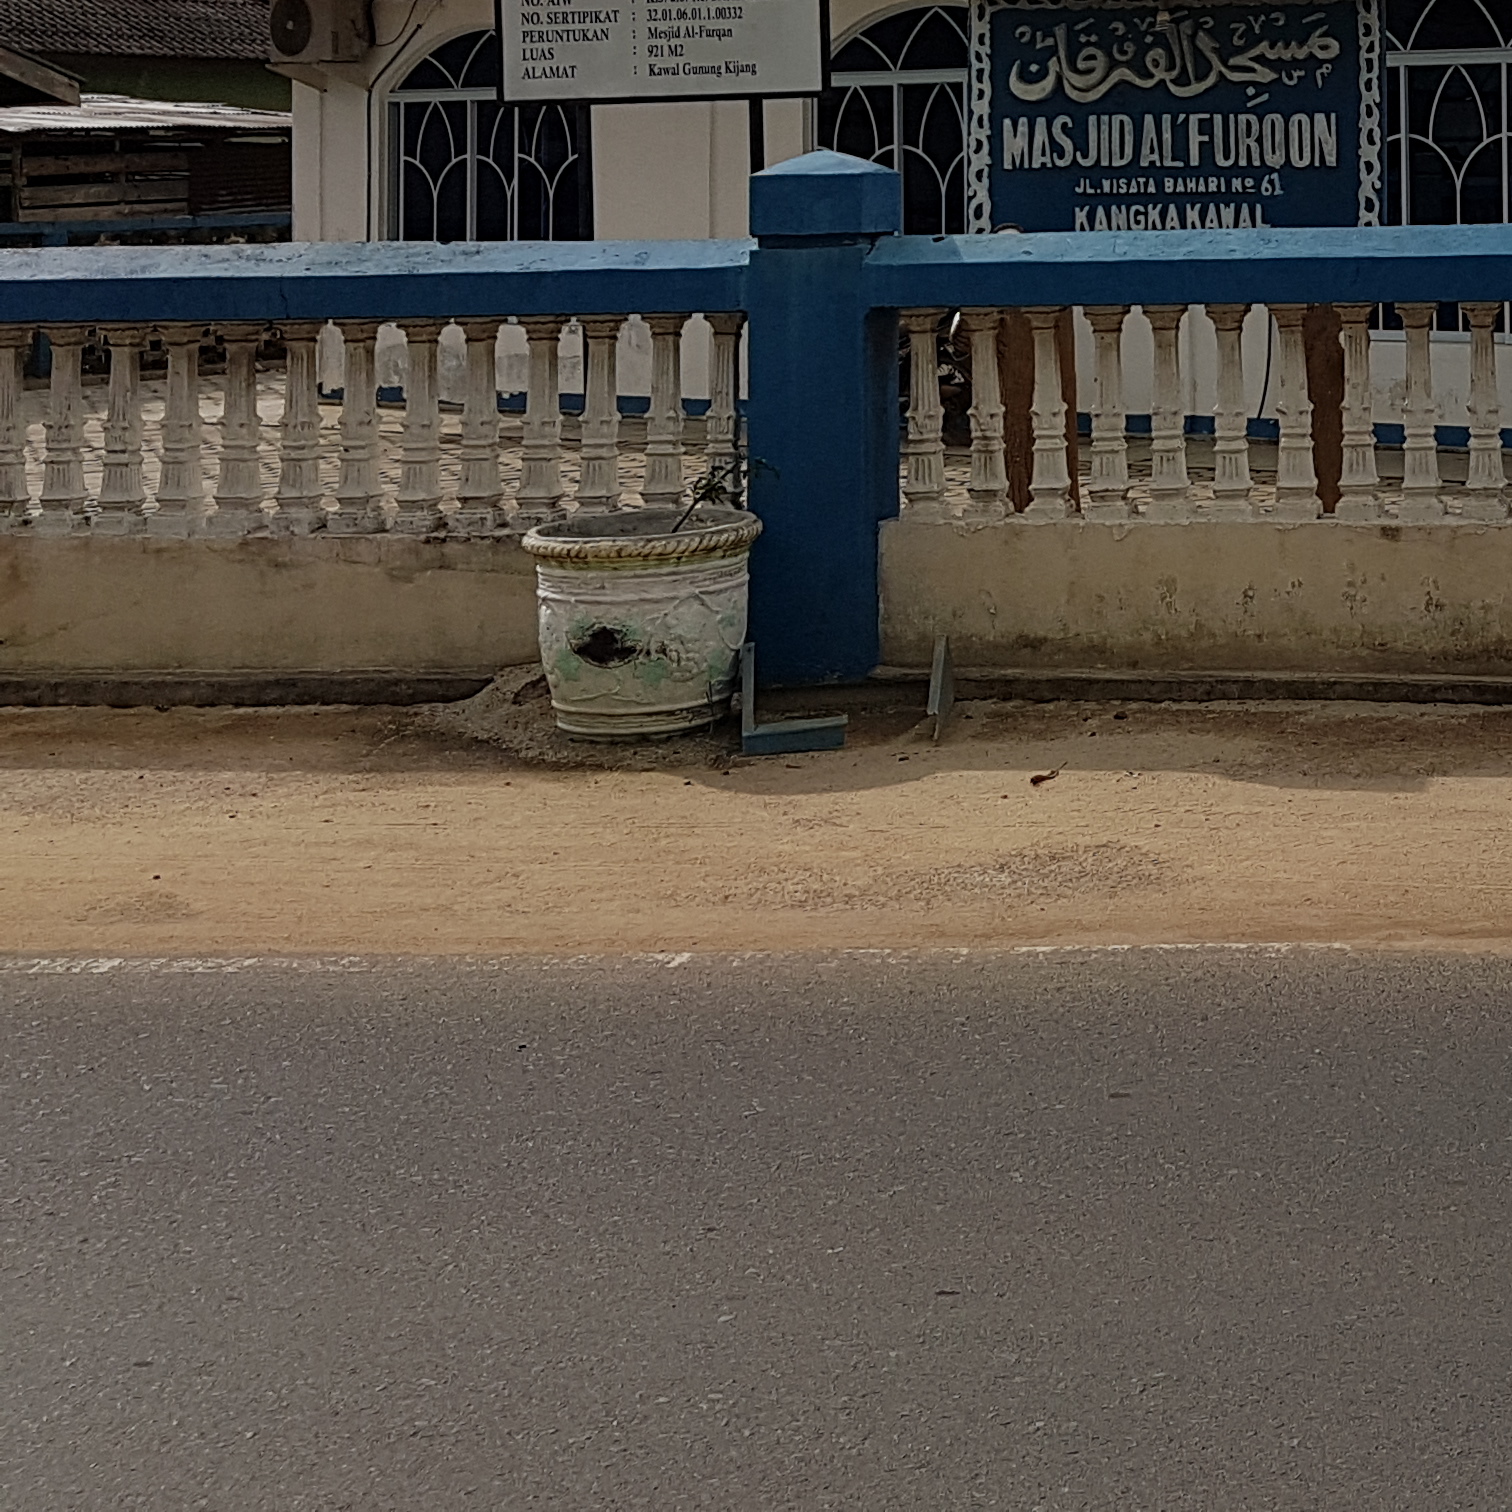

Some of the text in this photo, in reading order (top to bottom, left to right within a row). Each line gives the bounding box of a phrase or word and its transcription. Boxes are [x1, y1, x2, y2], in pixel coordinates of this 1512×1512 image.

[520, 11, 544, 26] NO.
[546, 9, 620, 25] SERTIPIKAT
[521, 27, 610, 44] PERUNTUKAN
[647, 25, 681, 42] Mesjid
[682, 24, 734, 42] Al-Furqan
[521, 47, 555, 62] LUAS
[646, 44, 665, 58] 921
[667, 44, 685, 58] M2
[521, 65, 577, 80] ALAMAT
[648, 63, 680, 77] Kawal
[682, 62, 722, 78] Gunung
[724, 60, 757, 77] Kijang
[1002, 113, 1134, 170] MASJID
[1163, 177, 1226, 194] BAHARI
[1260, 172, 1284, 196] 61
[1074, 202, 1272, 232] KANGKA KAWAL
